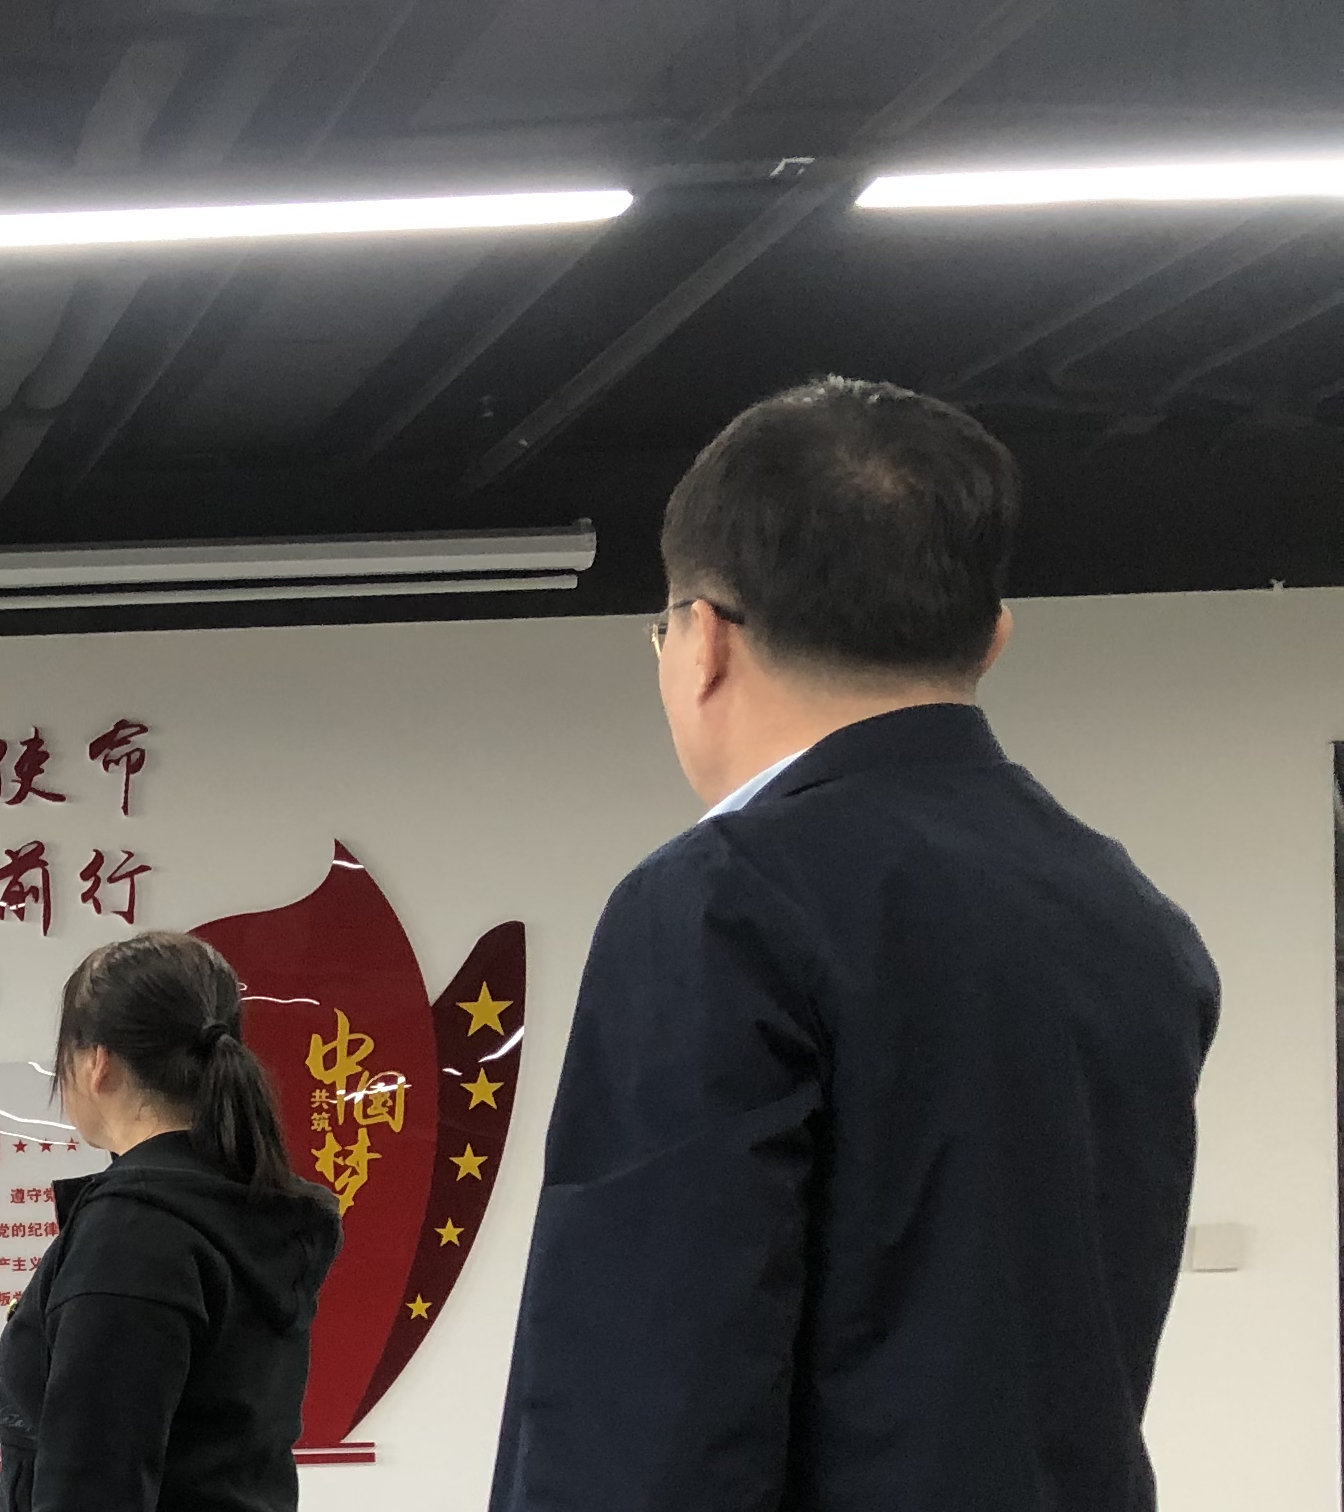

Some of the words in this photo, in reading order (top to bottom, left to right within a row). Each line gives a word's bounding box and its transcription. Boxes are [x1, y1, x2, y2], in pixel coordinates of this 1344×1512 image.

[305, 1007, 410, 1218] 中国梦
[311, 1088, 332, 1133] 共筑
